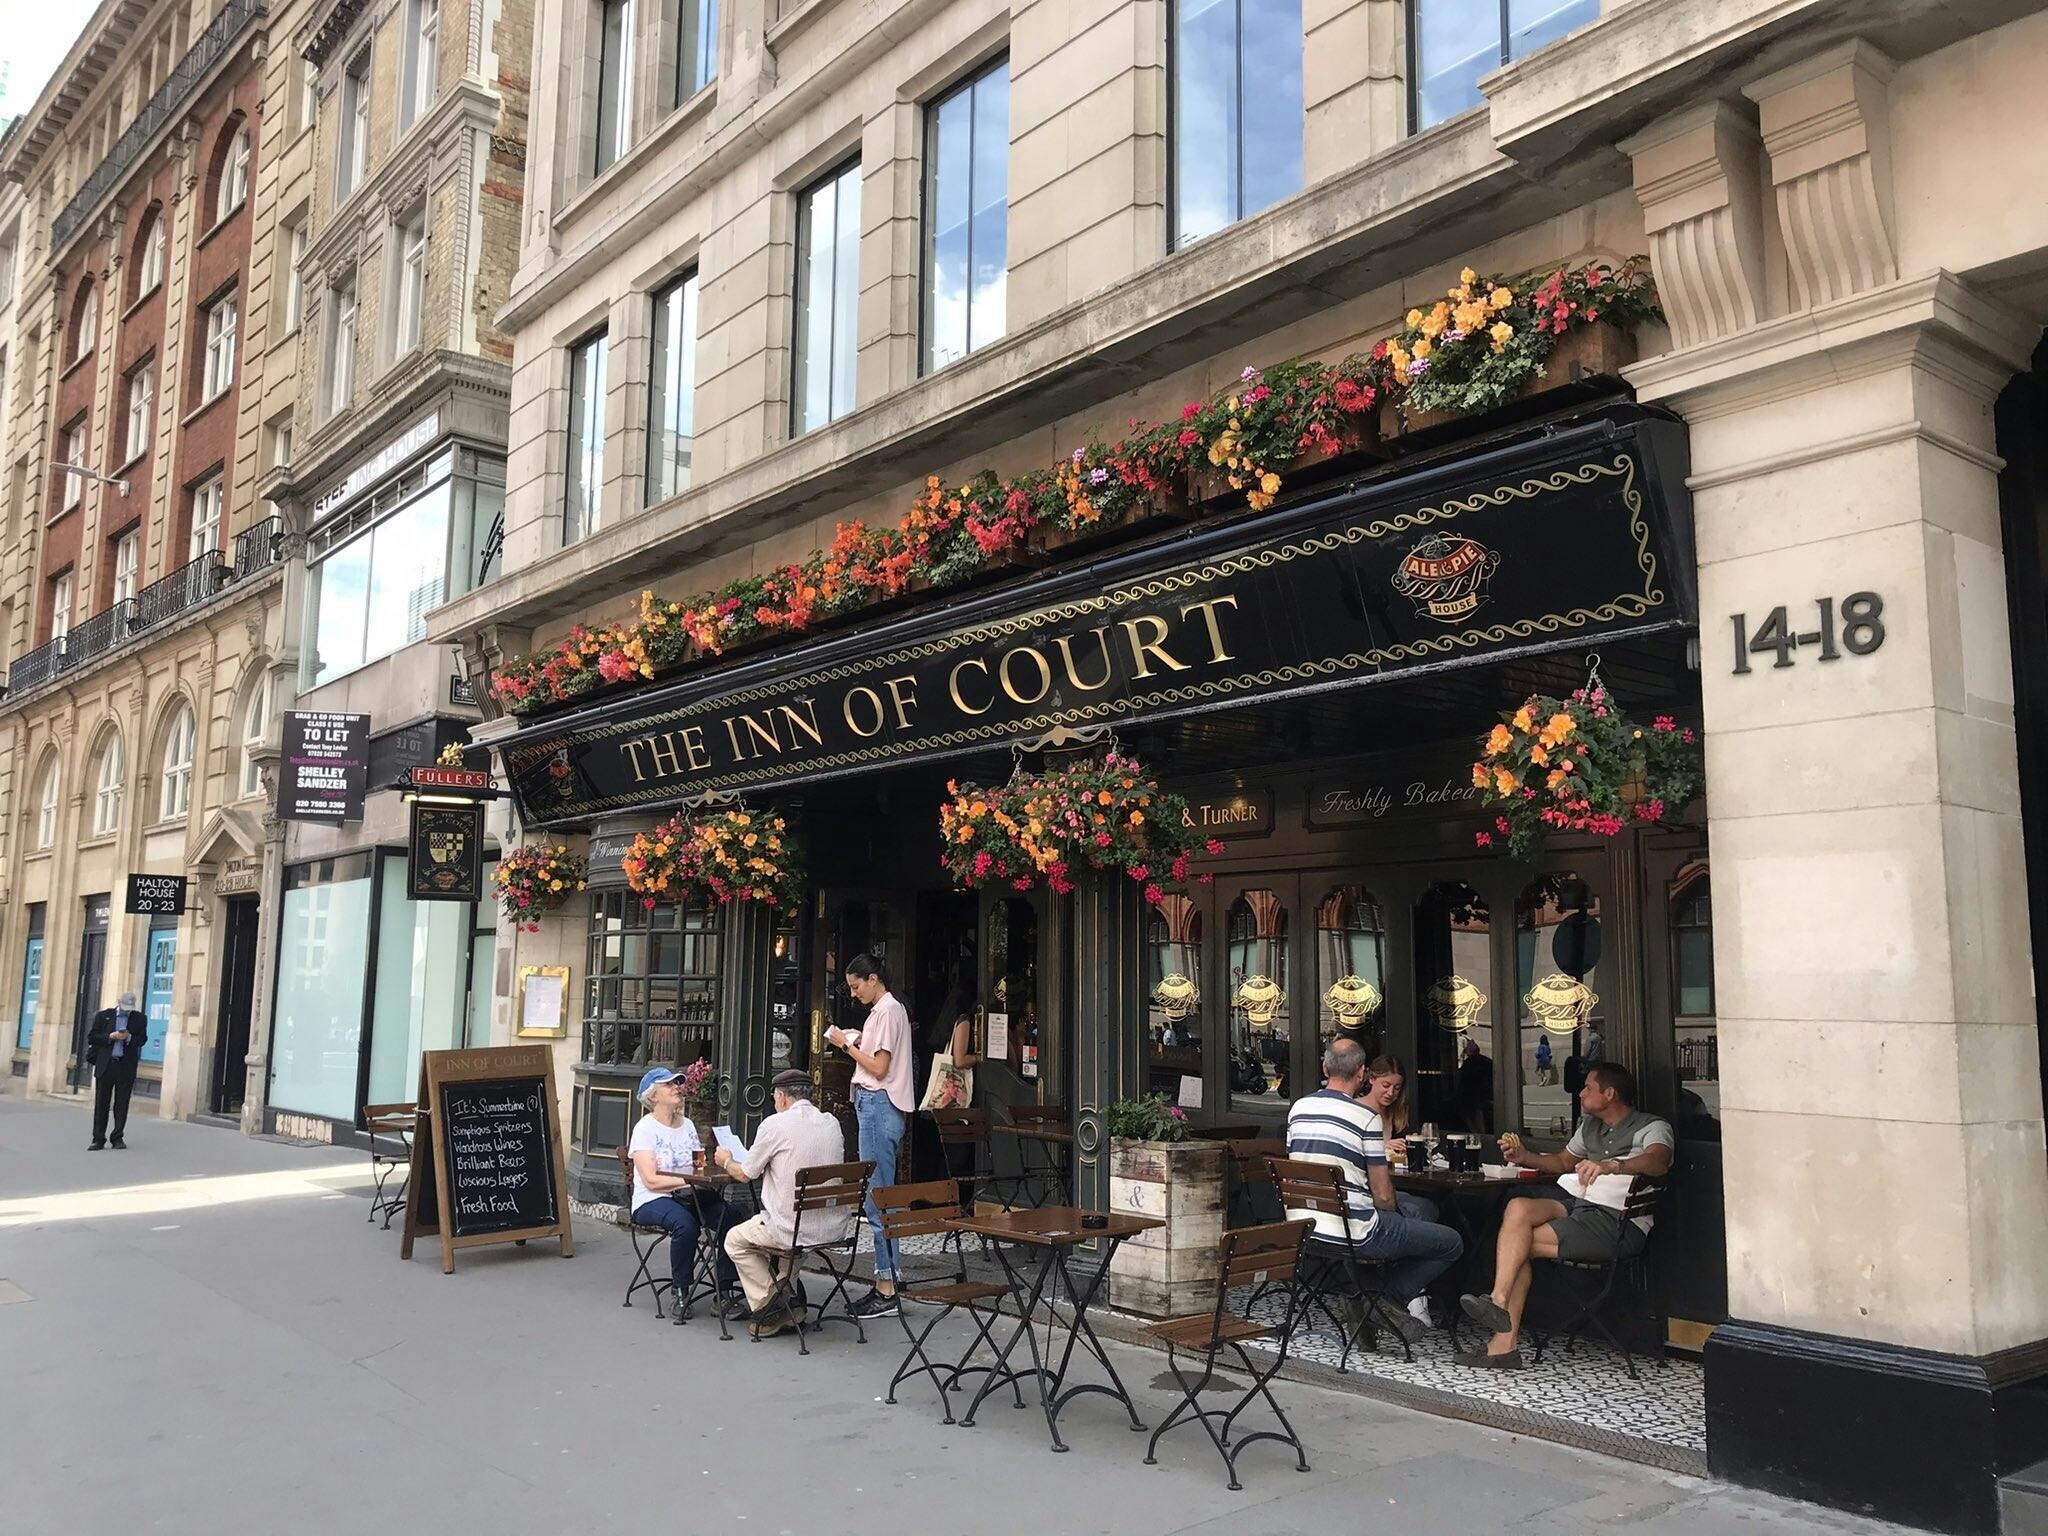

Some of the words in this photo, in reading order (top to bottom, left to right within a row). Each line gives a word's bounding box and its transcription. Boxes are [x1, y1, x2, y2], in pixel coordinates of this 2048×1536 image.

[1408, 561, 1438, 578] ALE
[1441, 561, 1454, 576] &
[1452, 546, 1478, 572] PIE
[1434, 600, 1474, 614] HOUSE
[1728, 591, 1886, 676] 14-18
[620, 726, 712, 782] THE
[722, 700, 824, 762] INN
[842, 675, 919, 739] OF
[949, 595, 1239, 716] COURT
[303, 729, 321, 740] TO
[325, 729, 350, 742] LET
[298, 766, 345, 778] SHELLEY
[297, 778, 347, 790] SANDZER
[1319, 786, 1393, 818] Freshly
[1181, 807, 1197, 828] &
[136, 878, 180, 889] HALTON
[139, 888, 175, 898] HOUSE
[137, 899, 152, 911] 20
[160, 901, 175, 911] 23
[446, 1058, 470, 1073] INN
[494, 1053, 537, 1068] COURT
[451, 1099, 477, 1116] It's
[478, 1097, 525, 1114] Summertime
[493, 1138, 525, 1152] Wines
[456, 1155, 496, 1170] Brilliant
[458, 1173, 497, 1188] Luscious
[460, 1195, 489, 1214] Fresh
[489, 1193, 520, 1214] Food
[1129, 1185, 1145, 1209] &
